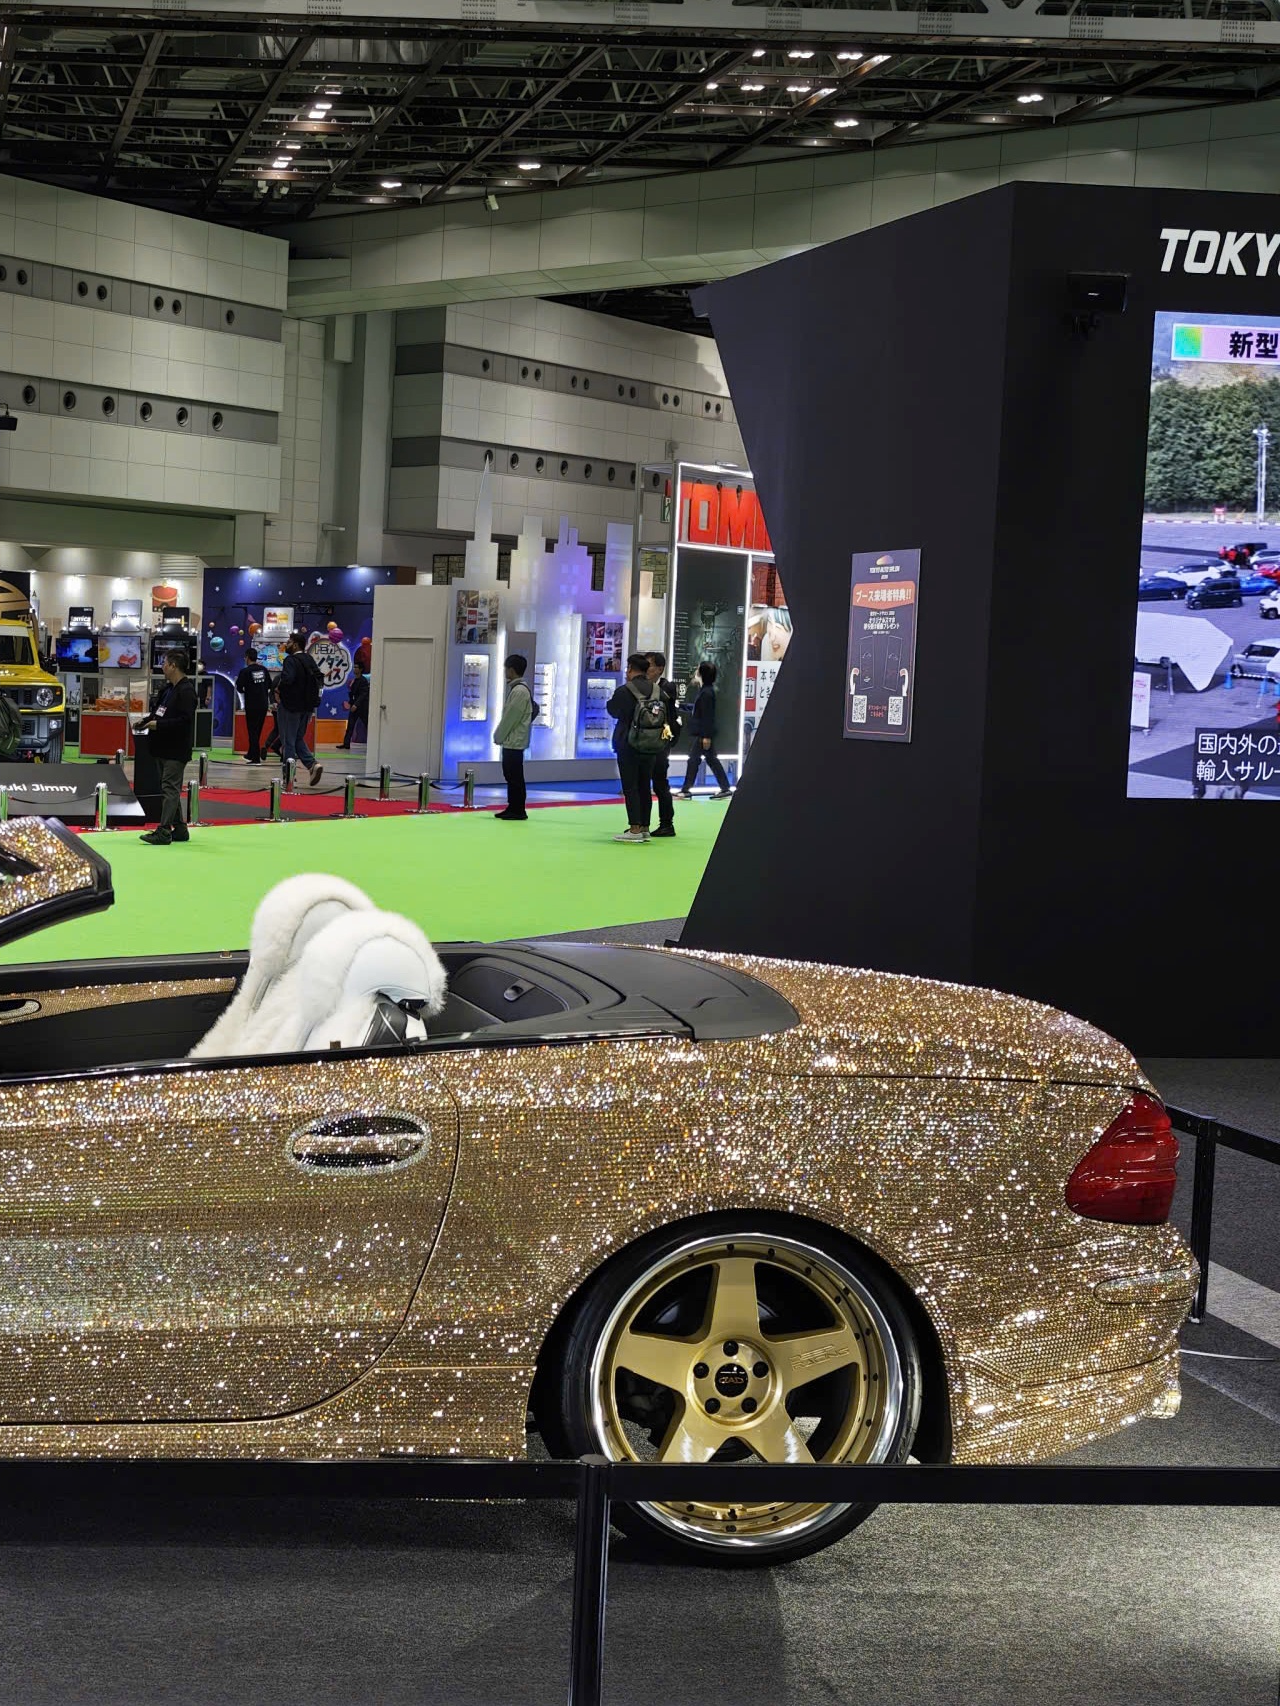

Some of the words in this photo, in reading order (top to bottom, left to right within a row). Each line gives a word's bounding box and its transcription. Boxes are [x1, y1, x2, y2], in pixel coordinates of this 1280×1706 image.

[1160, 228, 1280, 277] TOKY
[1228, 330, 1279, 359] 新型
[665, 479, 774, 552] TOMI
[31, 783, 78, 794] Jimny
